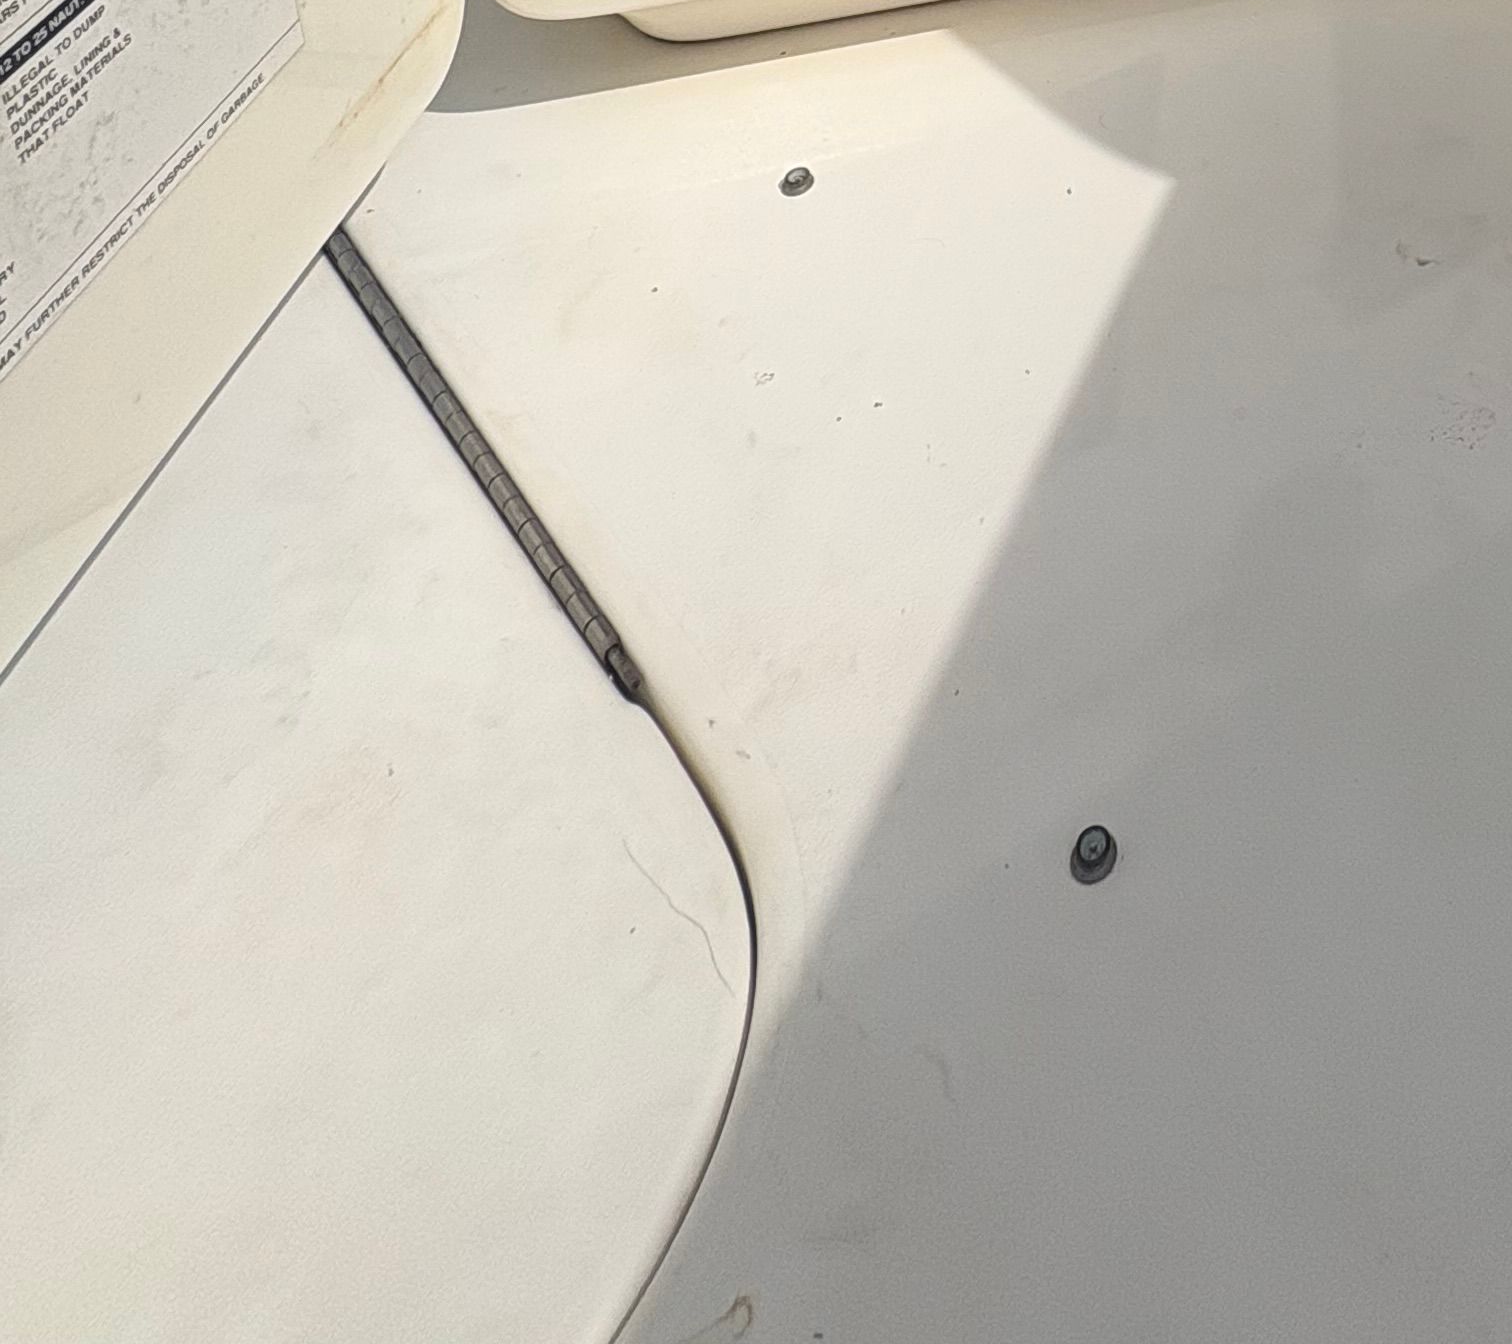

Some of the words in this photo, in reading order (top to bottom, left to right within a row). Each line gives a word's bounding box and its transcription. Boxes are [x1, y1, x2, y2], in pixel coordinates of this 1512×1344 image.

[1, 55, 54, 105] ILLEGAL
[54, 36, 72, 56] TO
[72, 4, 106, 40] DUMP
[13, 42, 32, 62] TO
[32, 26, 49, 47] 25
[73, 35, 112, 75] LINING
[6, 68, 59, 121] PLASTIC
[13, 94, 69, 150] PACKING
[69, 33, 132, 98] MATERIALS
[17, 128, 51, 164] THAT
[51, 90, 90, 135] FLOAT
[24, 275, 81, 343] FURTHER
[81, 214, 134, 279] RESTRICT
[134, 191, 157, 218] THE
[157, 139, 206, 196] DISPOSAL
[206, 120, 222, 141] OF
[220, 73, 266, 125] GARBAGE
